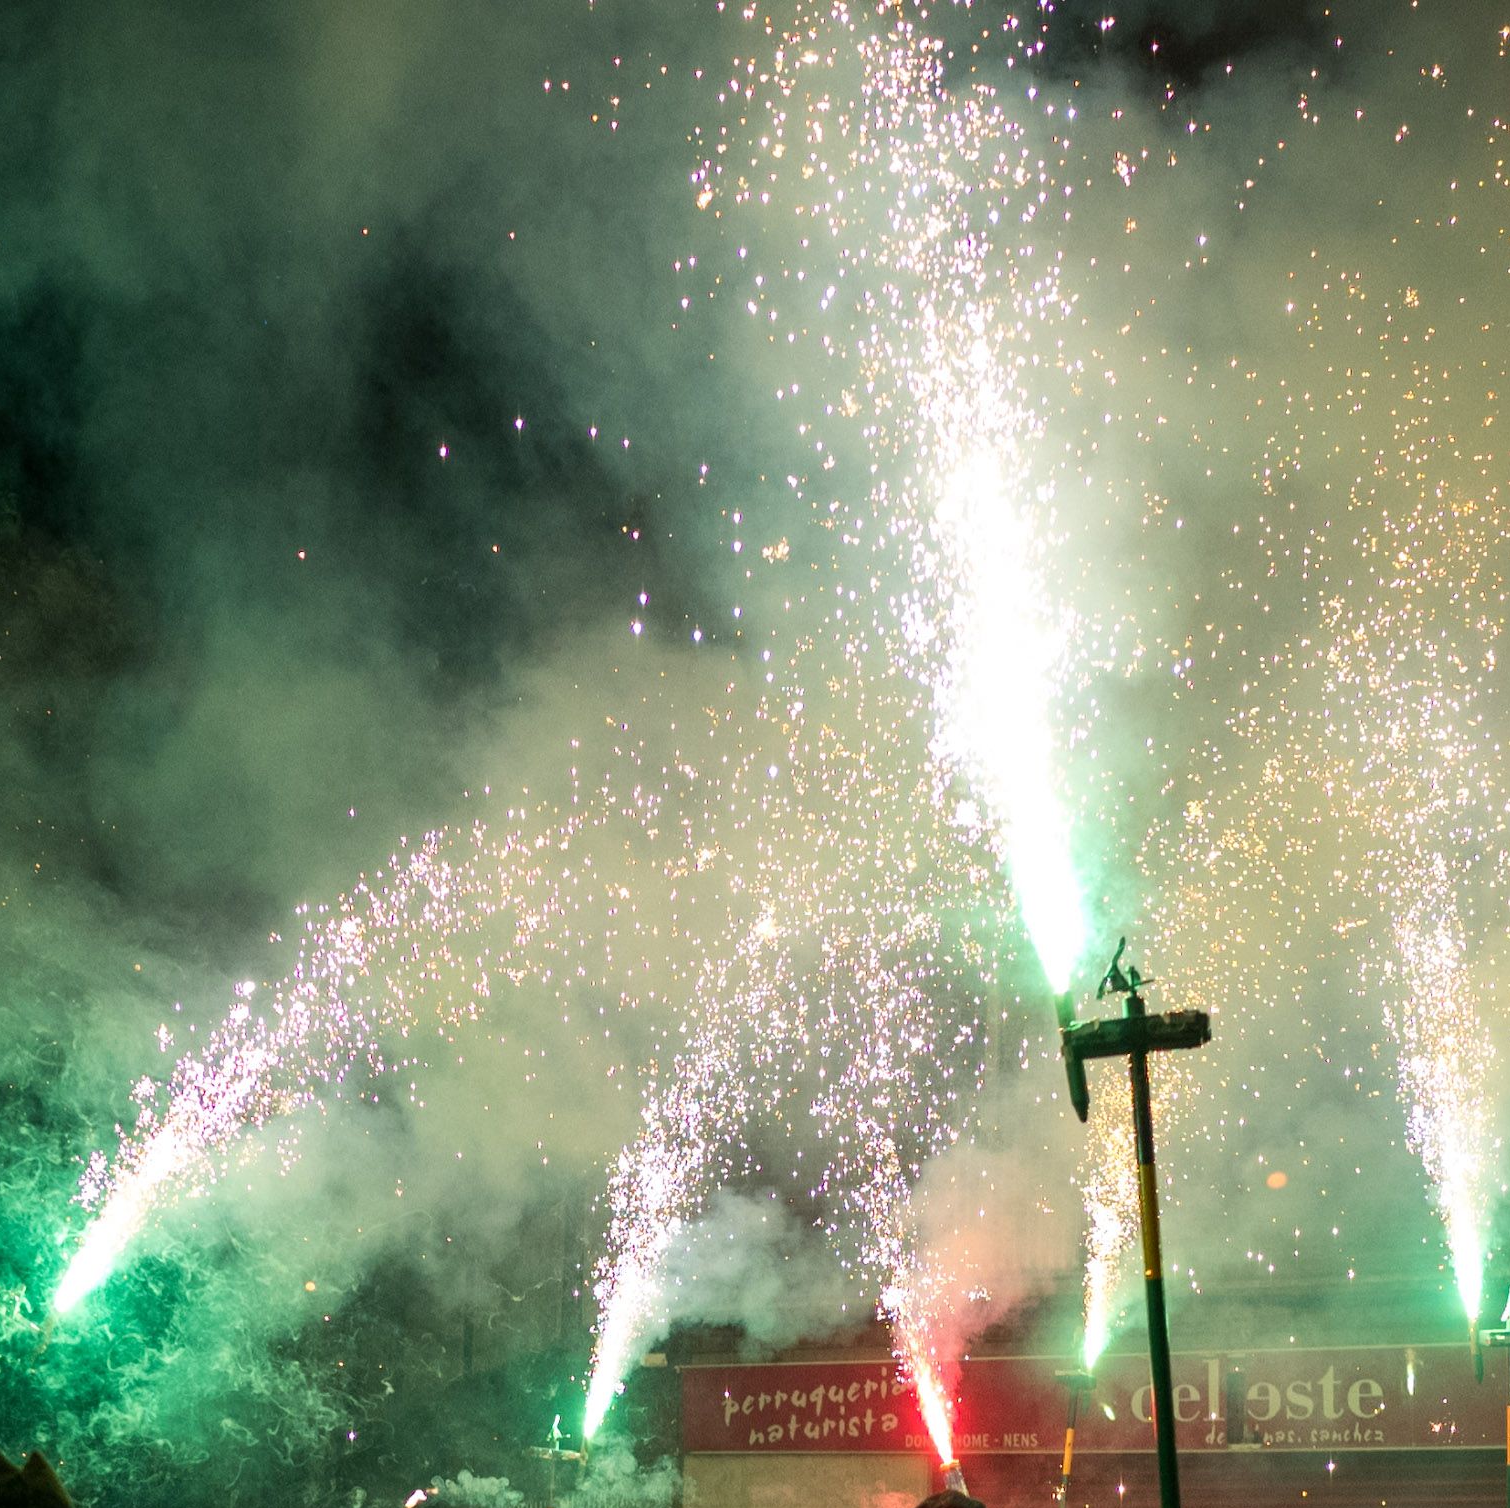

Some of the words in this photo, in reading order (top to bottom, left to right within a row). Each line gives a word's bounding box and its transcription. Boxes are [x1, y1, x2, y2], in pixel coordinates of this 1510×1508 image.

[749, 1405, 899, 1445] naturista
[1310, 1422, 1385, 1444] sanchez
[905, 1433, 934, 1448] DON
[1003, 1433, 1038, 1448] NENS
